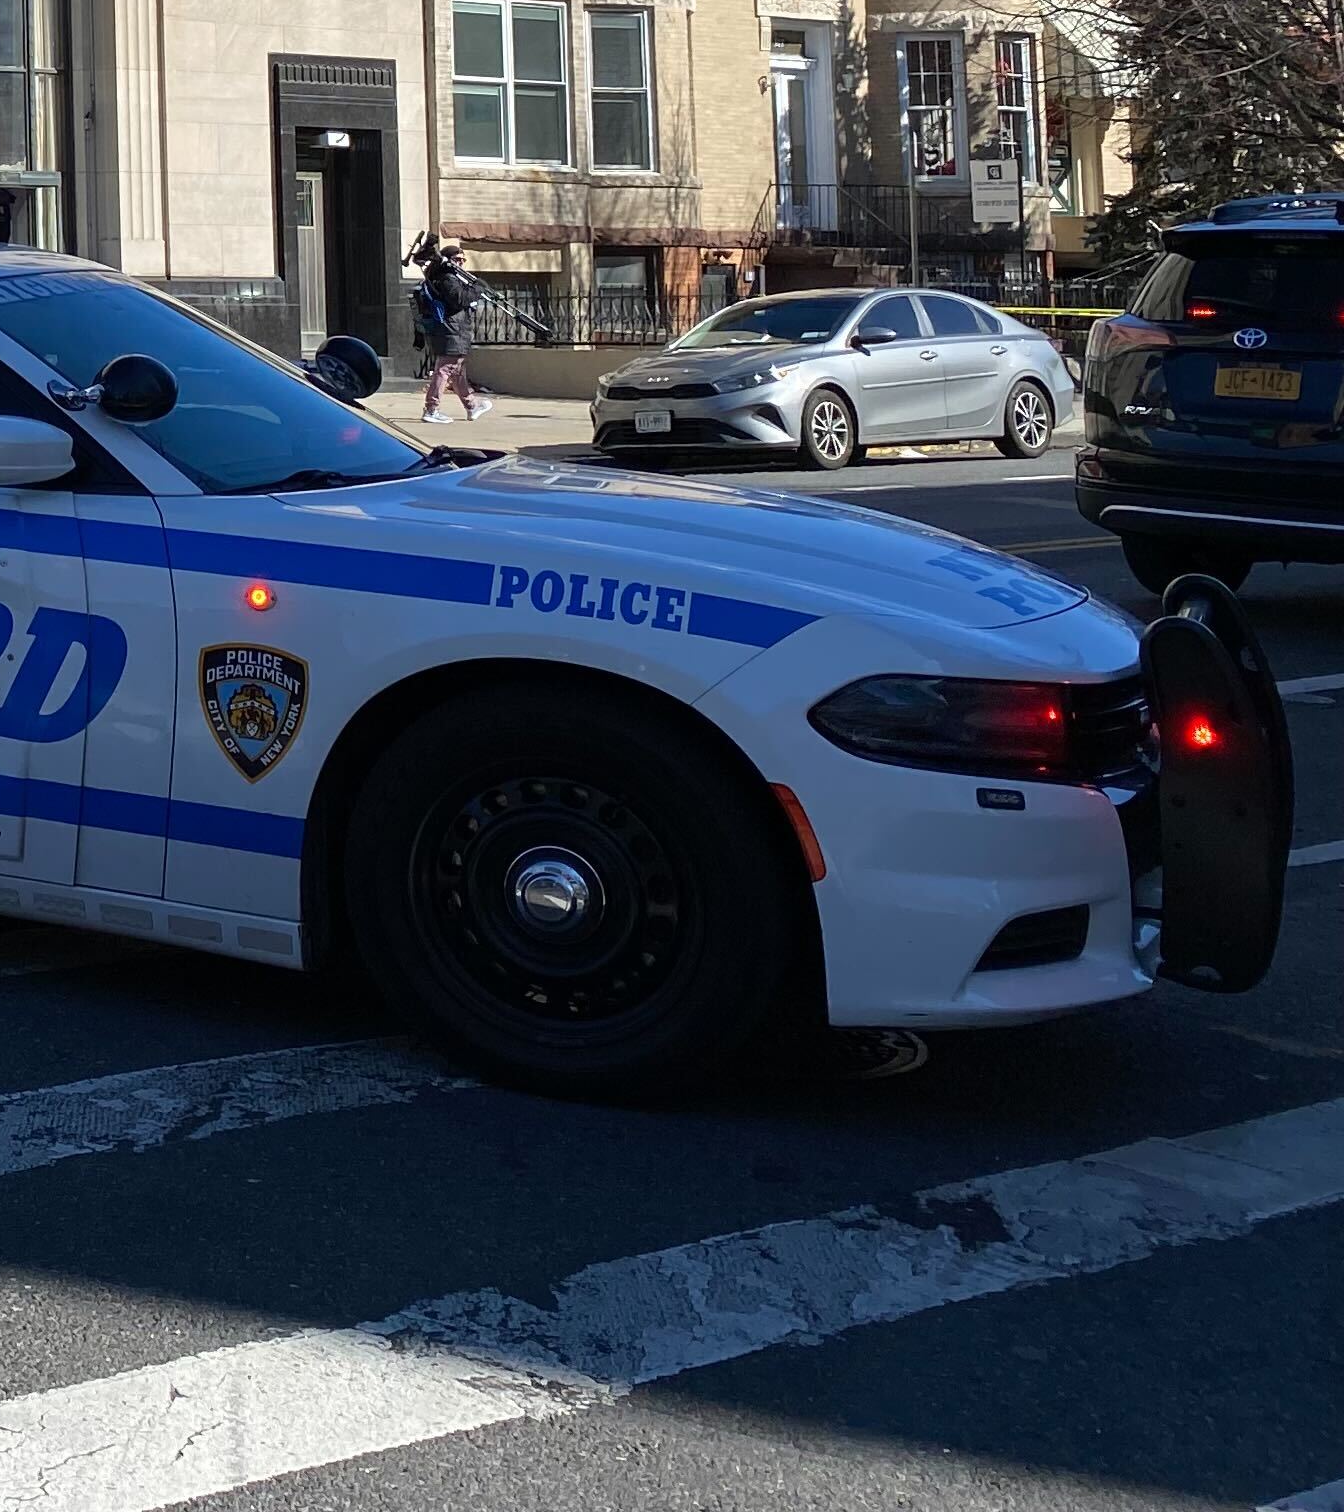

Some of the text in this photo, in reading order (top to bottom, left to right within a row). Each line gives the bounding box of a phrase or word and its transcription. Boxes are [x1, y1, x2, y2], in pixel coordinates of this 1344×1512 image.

[495, 564, 686, 633] POLICE
[206, 663, 301, 696] DEPARTMENT
[226, 650, 284, 672] POLICE
[206, 699, 241, 755] CITY OF
[260, 702, 301, 767] NEW YORK
